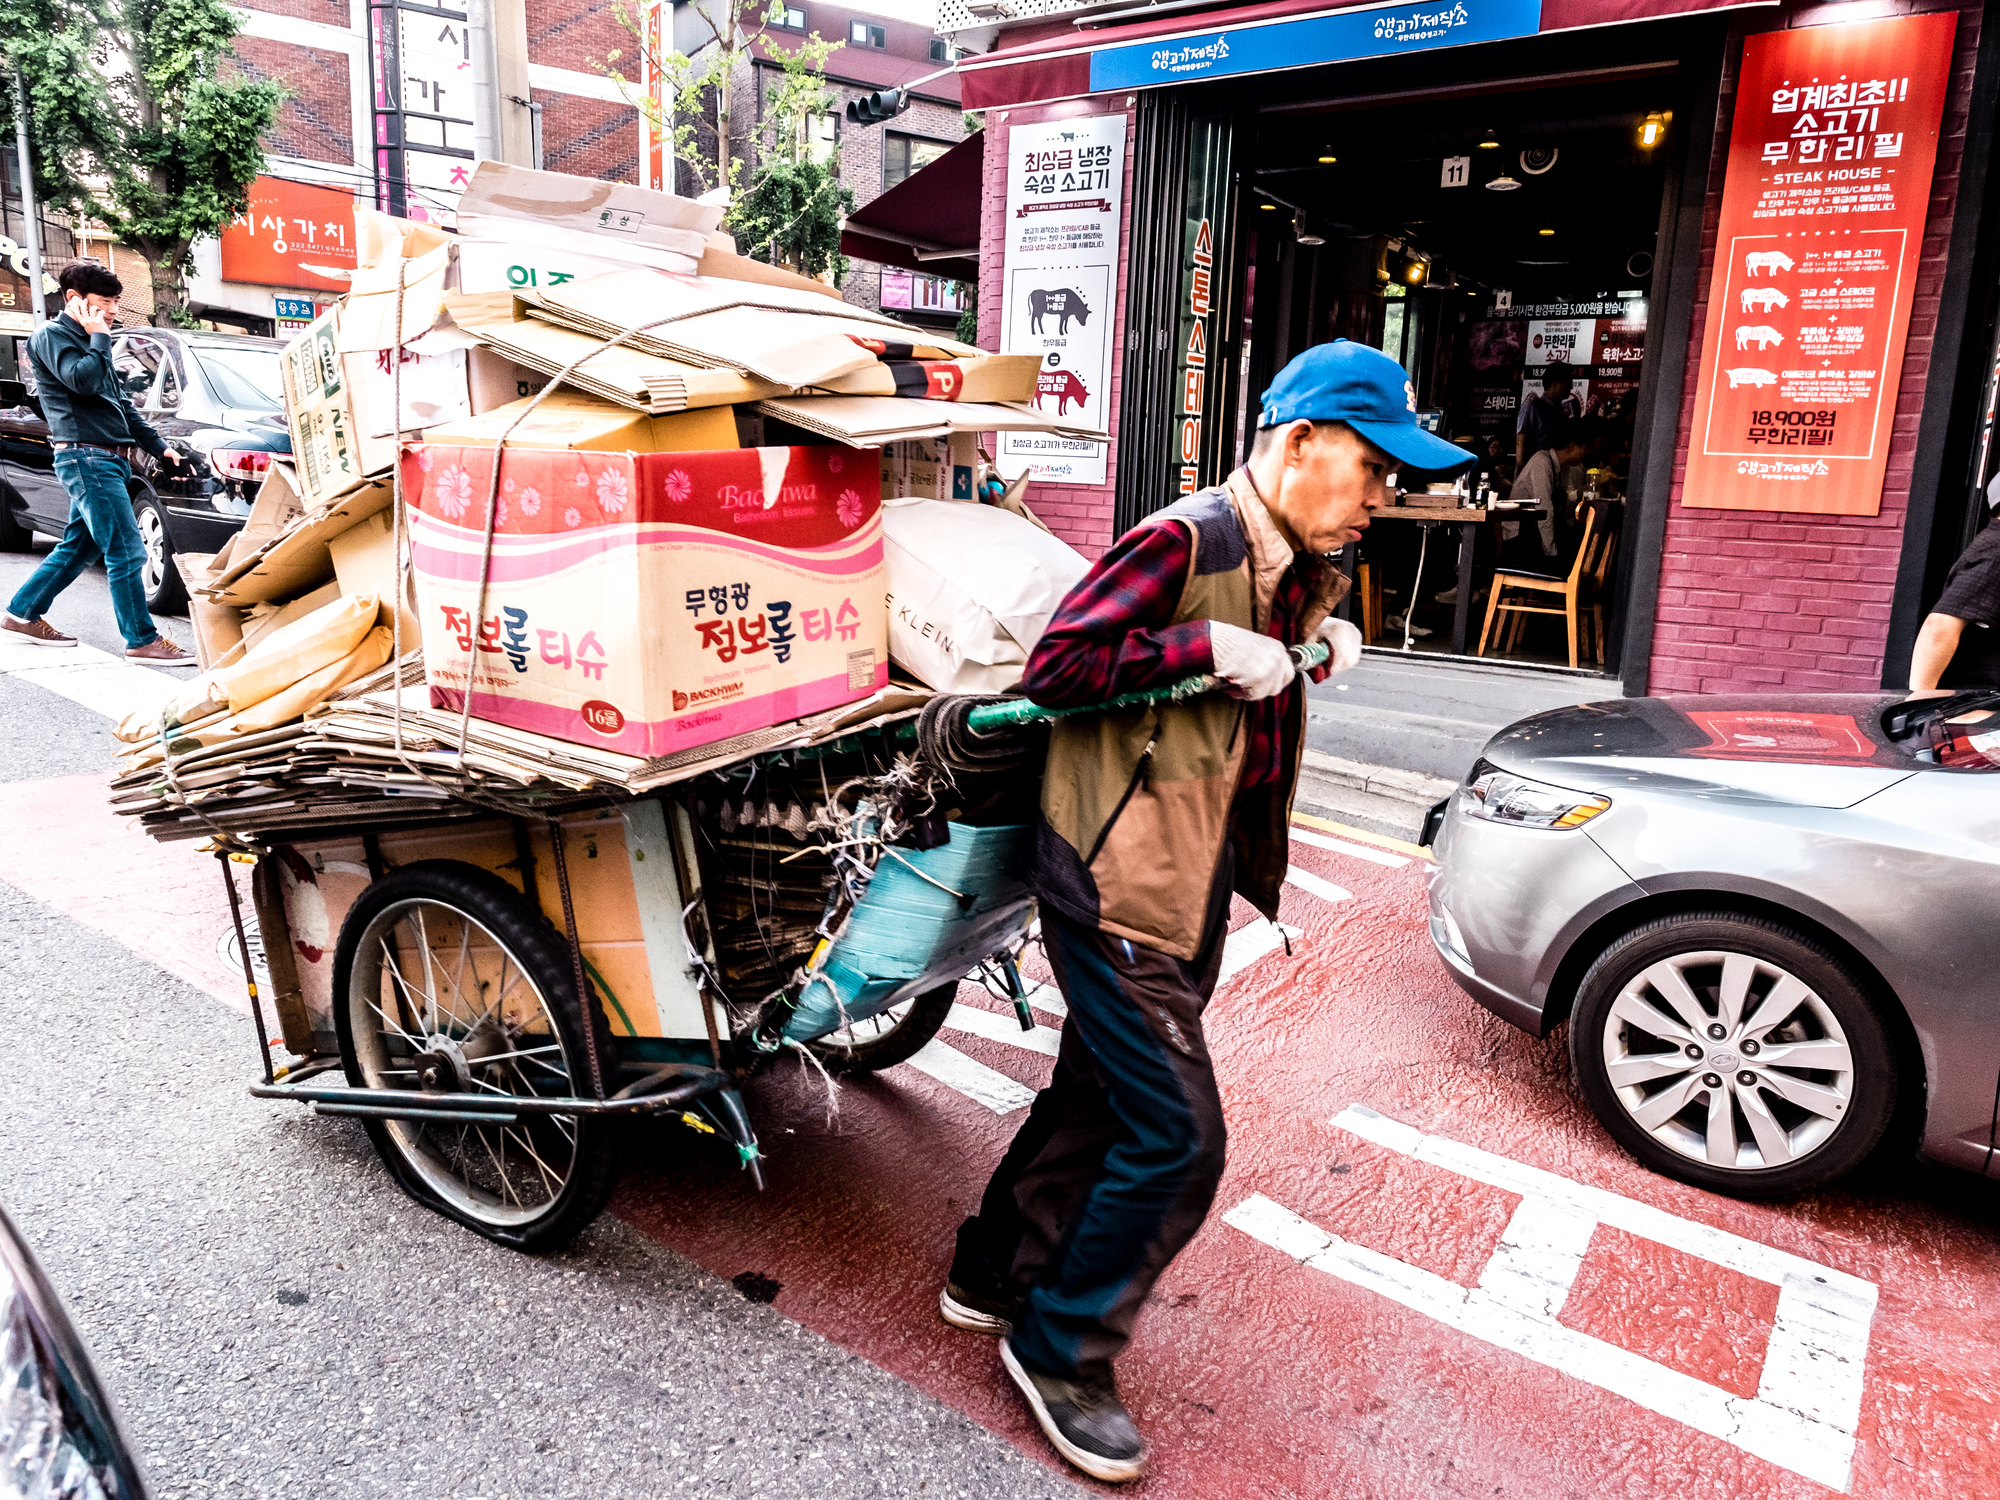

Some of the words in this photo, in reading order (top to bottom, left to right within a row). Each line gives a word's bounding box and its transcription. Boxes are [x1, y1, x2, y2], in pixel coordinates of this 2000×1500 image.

[1771, 77, 1909, 113] 업계최초!!
[1790, 107, 1879, 138] 소고기
[1025, 150, 1073, 173] 최상급
[1078, 145, 1112, 168] 냉장
[1024, 174, 1055, 194] 숙성
[1060, 168, 1109, 192] 소고기
[1448, 165, 1463, 182] 11
[1773, 170, 1823, 185] STEAK
[1828, 167, 1882, 181] HOUSE
[1853, 248, 1881, 258] 소고기
[1500, 296, 1507, 307] 4
[1570, 302, 1603, 316] 5,000원을
[1544, 334, 1576, 349] 무한리필
[1546, 349, 1571, 362] 소고기
[1598, 367, 1623, 377] 19,900원
[1483, 395, 1516, 410] 스테이크
[331, 409, 351, 474] NEW
[1012, 439, 1032, 448] 최상급
[1033, 440, 1060, 449] 소고기가
[1747, 428, 1833, 446] 무한리필!
[717, 483, 817, 509] Bacwa
[734, 510, 779, 524] Bathroom
[685, 581, 751, 617] 무형광
[694, 600, 796, 664] 점보롤
[800, 597, 861, 642] 티슈
[898, 605, 953, 653] KLEIN
[440, 605, 531, 673] 점보롤
[536, 629, 609, 681] 티슈
[690, 682, 743, 702] BACKHWA
[587, 707, 618, 729] 16롤
